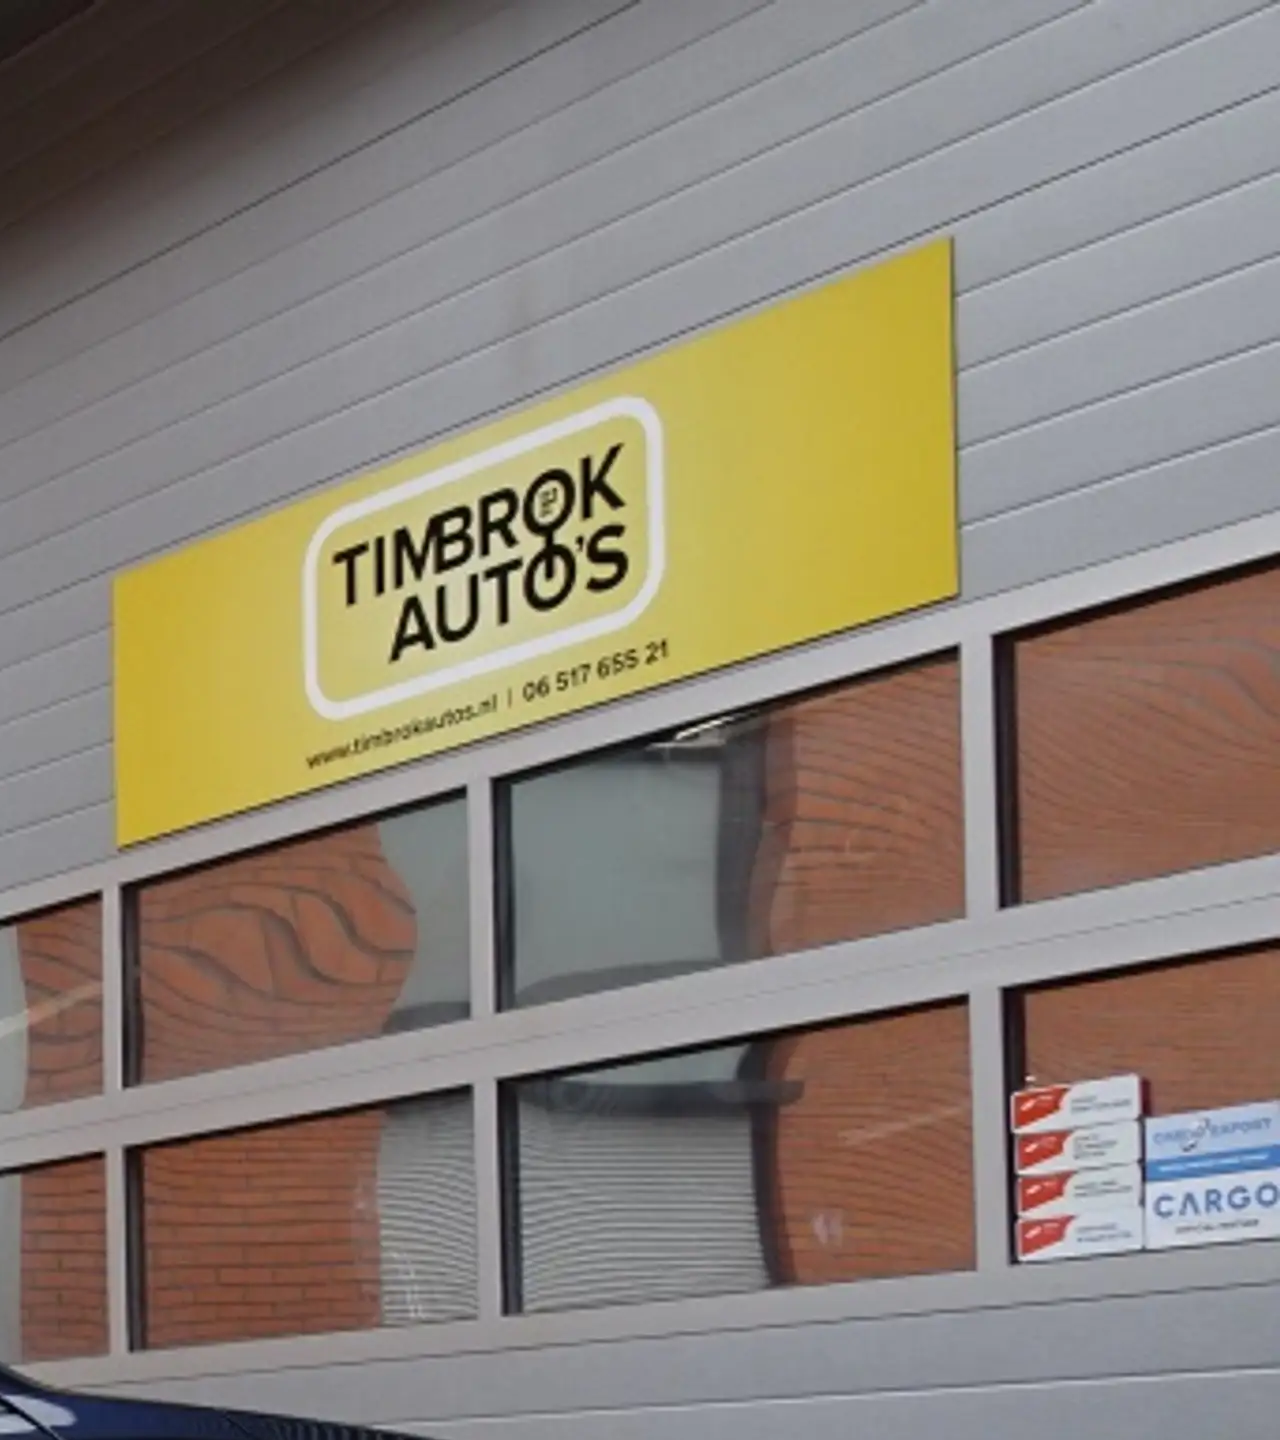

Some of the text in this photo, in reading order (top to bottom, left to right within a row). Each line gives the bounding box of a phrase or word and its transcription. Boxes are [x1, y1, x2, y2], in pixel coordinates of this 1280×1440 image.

[333, 442, 626, 607] TIMBROK
[388, 524, 630, 665] AUTO'S
[306, 638, 670, 769] www.timbrokautos.nl 06 517 655 21
[1153, 1182, 1279, 1218] CARGO
